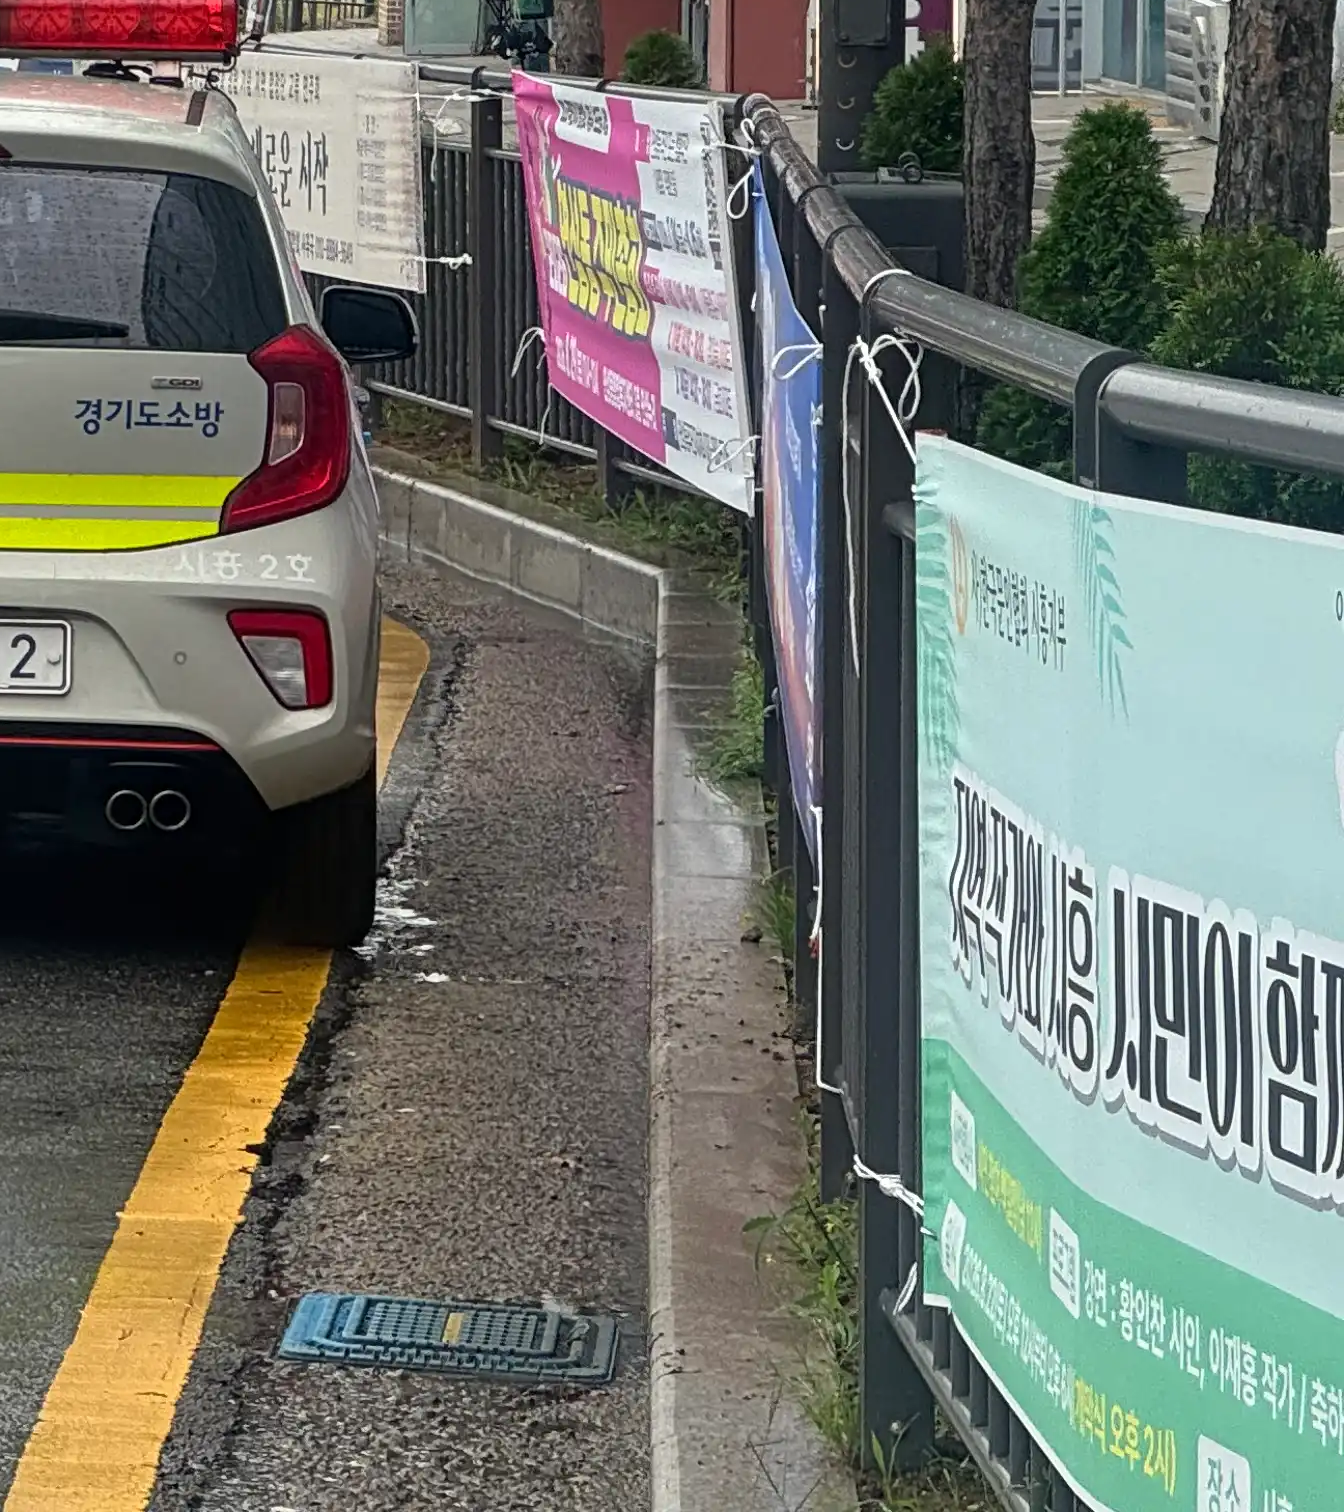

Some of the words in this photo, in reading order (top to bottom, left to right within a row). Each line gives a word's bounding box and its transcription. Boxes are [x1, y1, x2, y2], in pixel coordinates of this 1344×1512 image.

[298, 129, 329, 216] 시작
[74, 397, 225, 438] 경기도소방
[258, 552, 315, 583] 2호
[1031, 580, 1067, 672] 시흥지부
[1084, 1260, 1107, 1328] 강연
[1119, 1277, 1166, 1359] 황인찬
[1208, 1327, 1257, 1407] 이재홍
[1261, 1351, 1295, 1429] 작가
[1109, 1404, 1141, 1472] 오후
